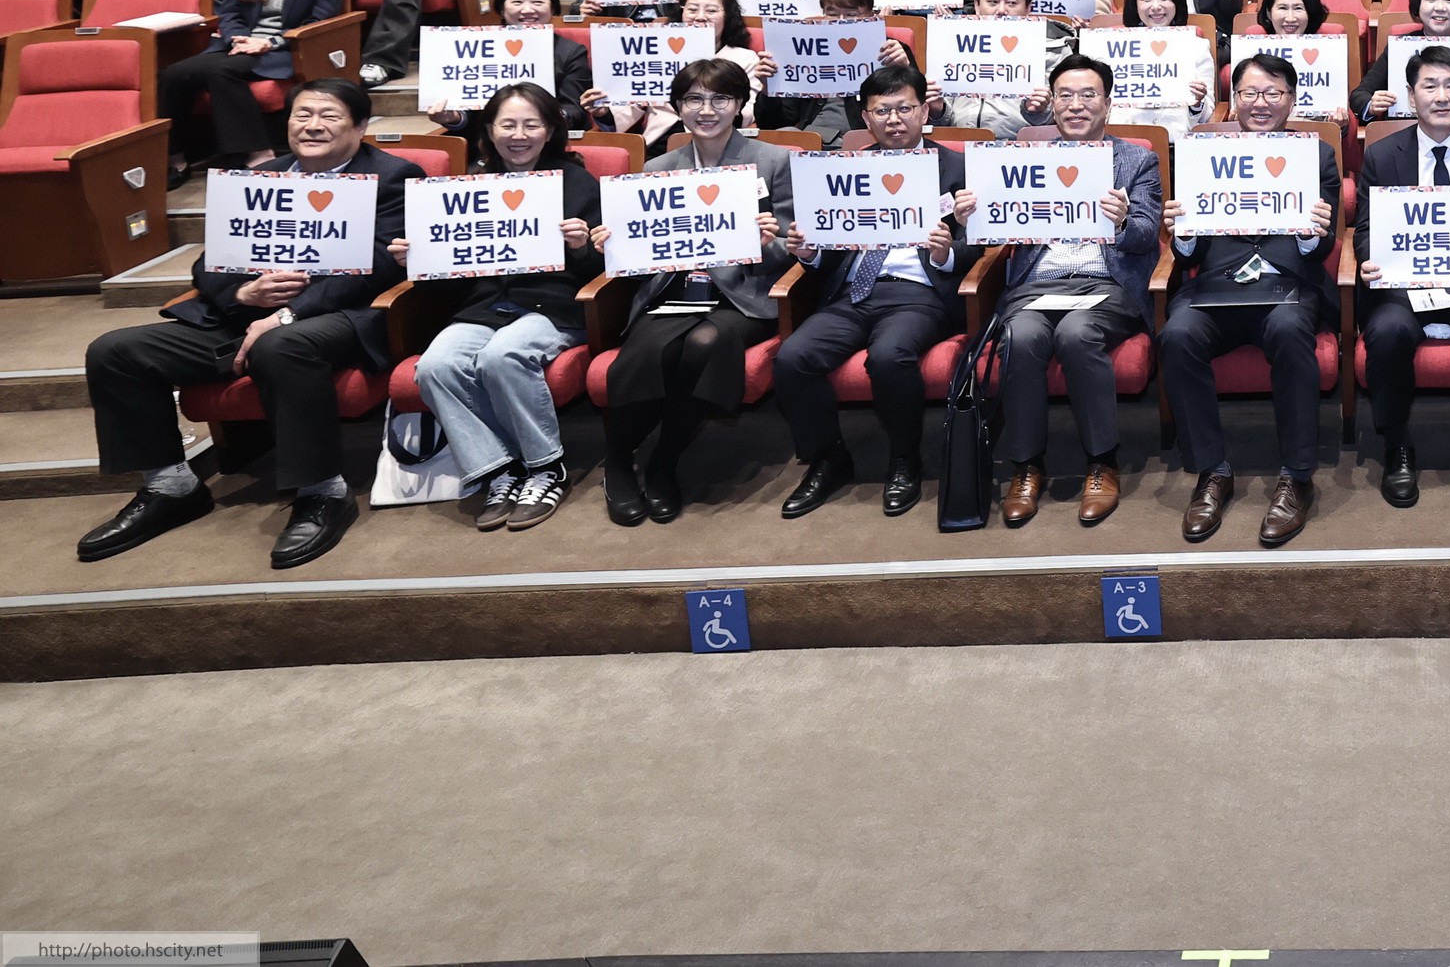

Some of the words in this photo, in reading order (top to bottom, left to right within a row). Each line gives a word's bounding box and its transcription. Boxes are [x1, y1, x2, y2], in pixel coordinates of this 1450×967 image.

[758, 2, 799, 16] 보건소
[1029, 0, 1067, 16] 보건소
[455, 39, 496, 59] WE
[621, 35, 659, 56] WE
[791, 36, 830, 57] WE
[956, 33, 992, 54] WE
[1107, 40, 1142, 59] WE
[441, 63, 536, 81] 화성특례시
[461, 84, 501, 101] 보건
[1113, 82, 1162, 100] 보건소
[1001, 164, 1046, 190] WE
[1210, 154, 1255, 180] WE
[825, 173, 871, 197] WE
[244, 186, 295, 213] WE
[441, 189, 491, 217] WE
[637, 185, 687, 212] WE
[1403, 201, 1447, 226] WE
[228, 217, 348, 242] 화성특례시
[429, 217, 540, 244] 화성특례시
[627, 211, 737, 240] 화성특례시
[250, 242, 321, 265] 보건소
[452, 243, 518, 266] 보건소
[651, 236, 716, 262] 보건소
[1114, 581, 1147, 594] A-3
[699, 595, 733, 609] A-4
